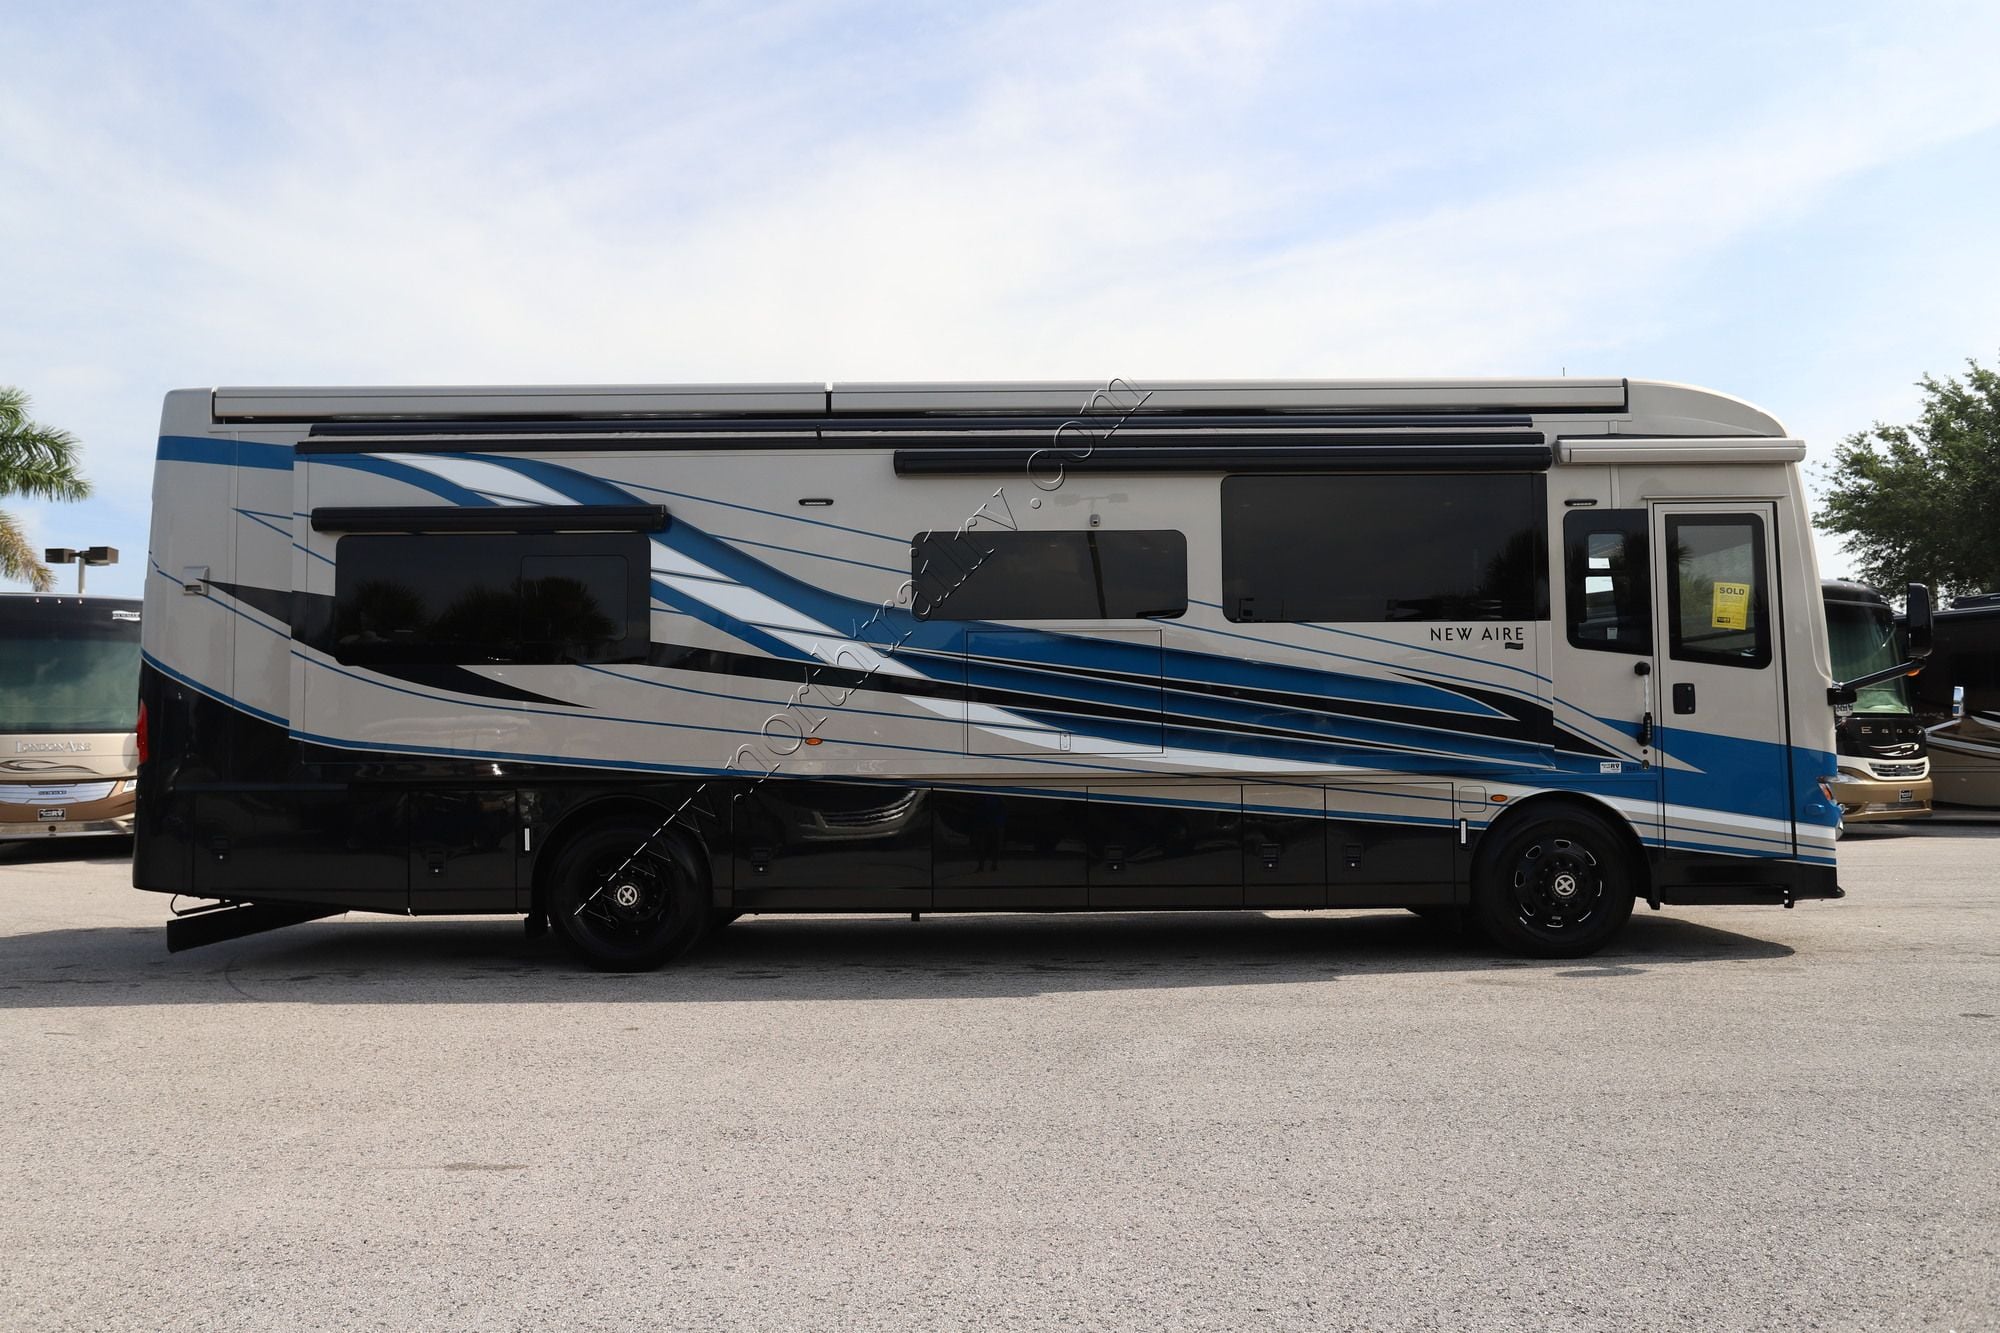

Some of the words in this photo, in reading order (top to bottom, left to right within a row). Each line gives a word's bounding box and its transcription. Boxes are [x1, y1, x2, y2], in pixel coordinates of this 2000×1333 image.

[1719, 587, 1744, 595] SOLD
[1430, 627, 1472, 641] NEW
[1481, 627, 1524, 641] AIRE
